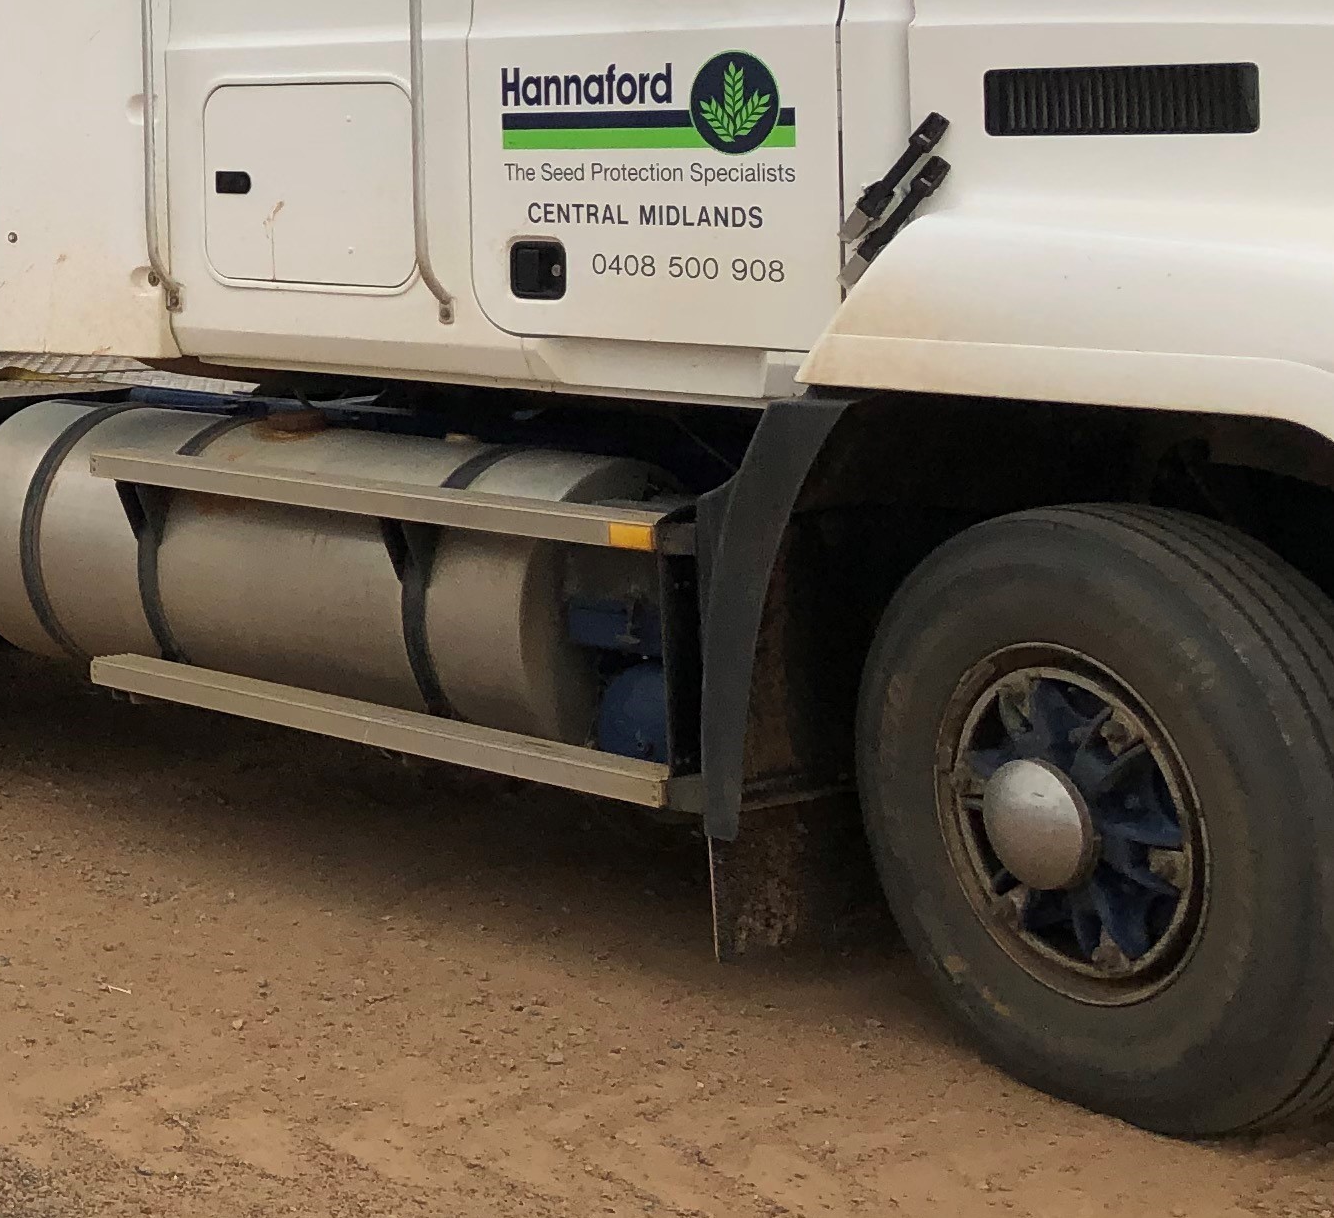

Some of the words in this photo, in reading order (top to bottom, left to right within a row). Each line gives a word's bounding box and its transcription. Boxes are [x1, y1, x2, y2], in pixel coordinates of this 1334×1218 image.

[501, 62, 673, 107] Hannaford
[504, 163, 536, 182] The
[541, 163, 585, 182] Seed
[591, 162, 683, 182] Protection
[690, 162, 796, 186] Specialists
[528, 202, 629, 225] CENTRAL
[639, 205, 764, 229] MIDLANDS
[592, 253, 656, 277] 0408
[668, 257, 719, 280] 500
[732, 258, 785, 283] 908
